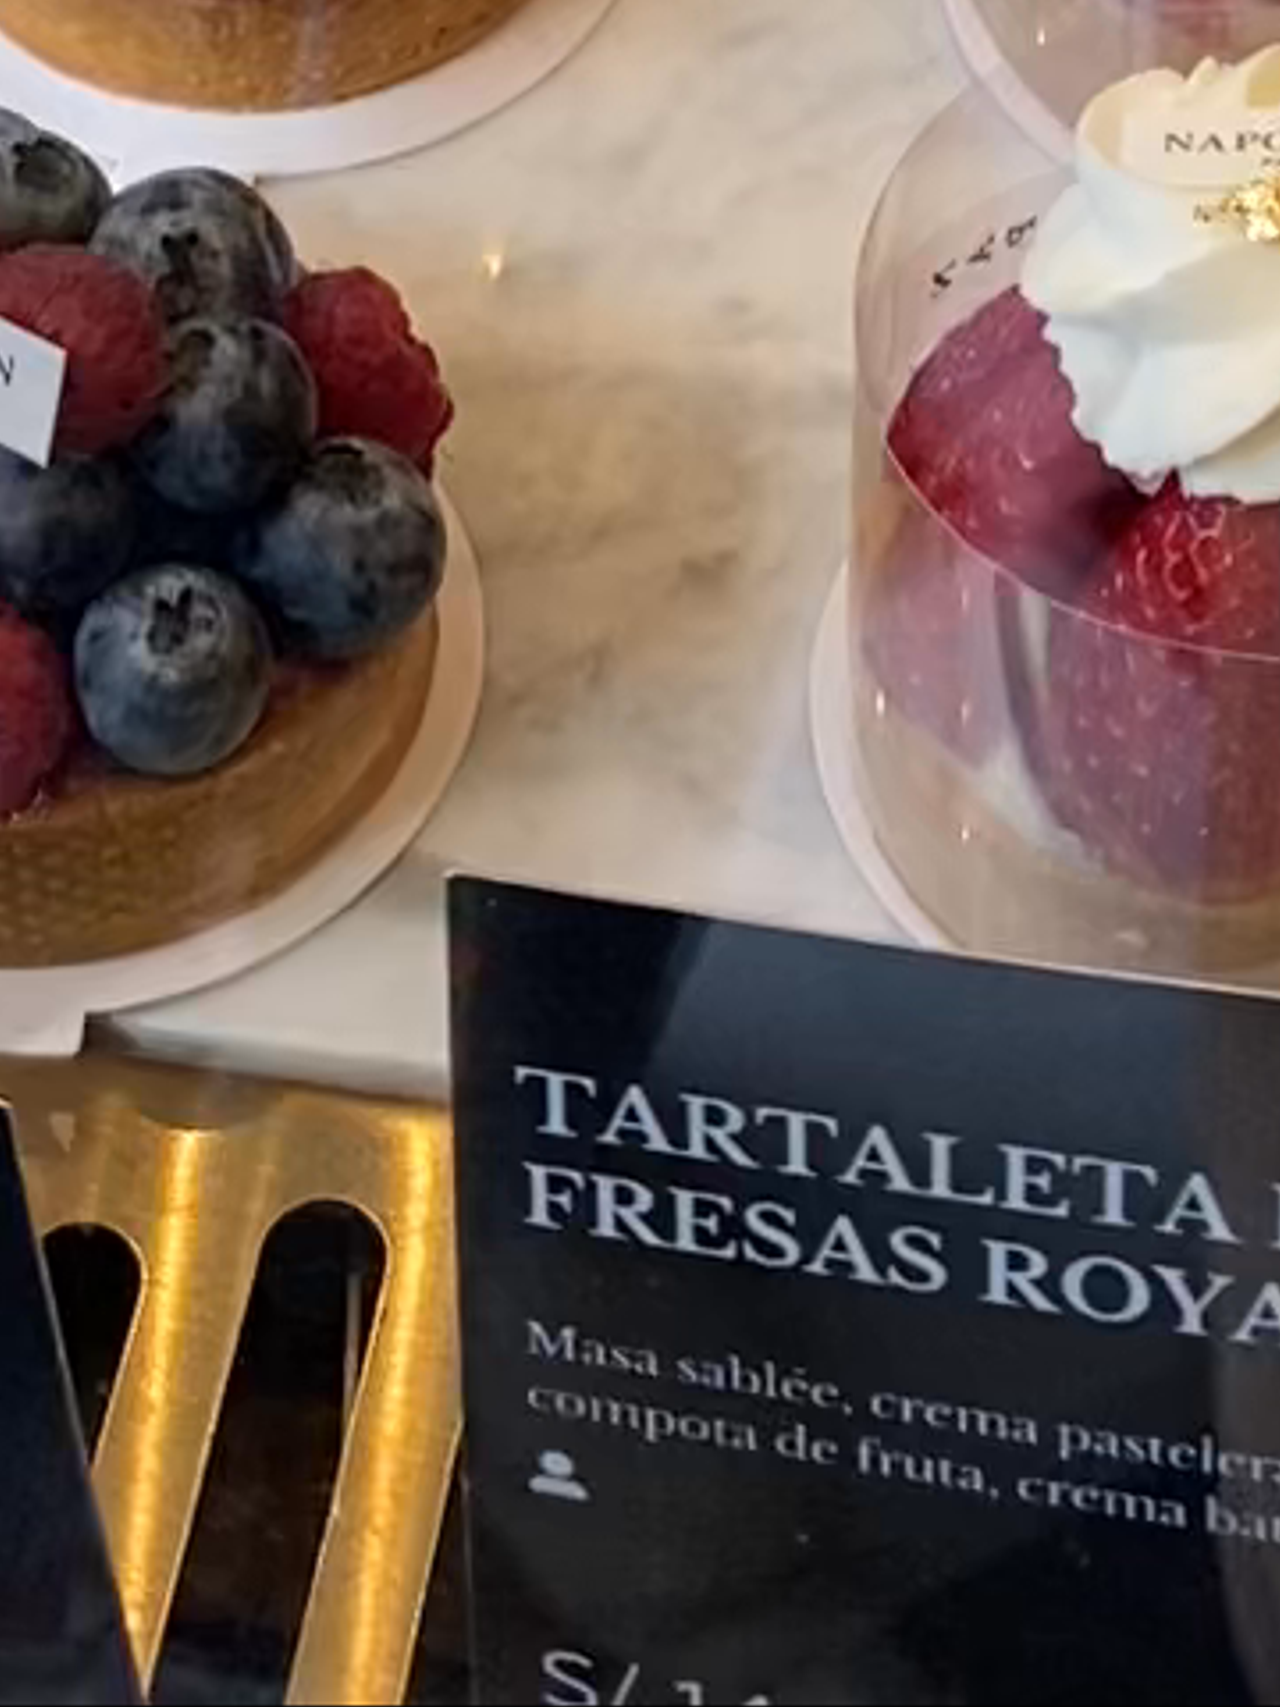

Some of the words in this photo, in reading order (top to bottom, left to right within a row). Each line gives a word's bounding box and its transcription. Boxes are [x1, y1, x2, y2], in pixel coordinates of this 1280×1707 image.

[514, 1064, 1243, 1244] TARTALETA
[521, 1161, 949, 1293] FRESAS
[527, 1319, 661, 1378] Masa
[677, 1353, 854, 1415] sablée,
[870, 1390, 1038, 1446] crema
[526, 1386, 758, 1443] compota
[776, 1423, 840, 1464] de
[857, 1436, 1001, 1500] fruta,
[1017, 1476, 1188, 1529] crema
